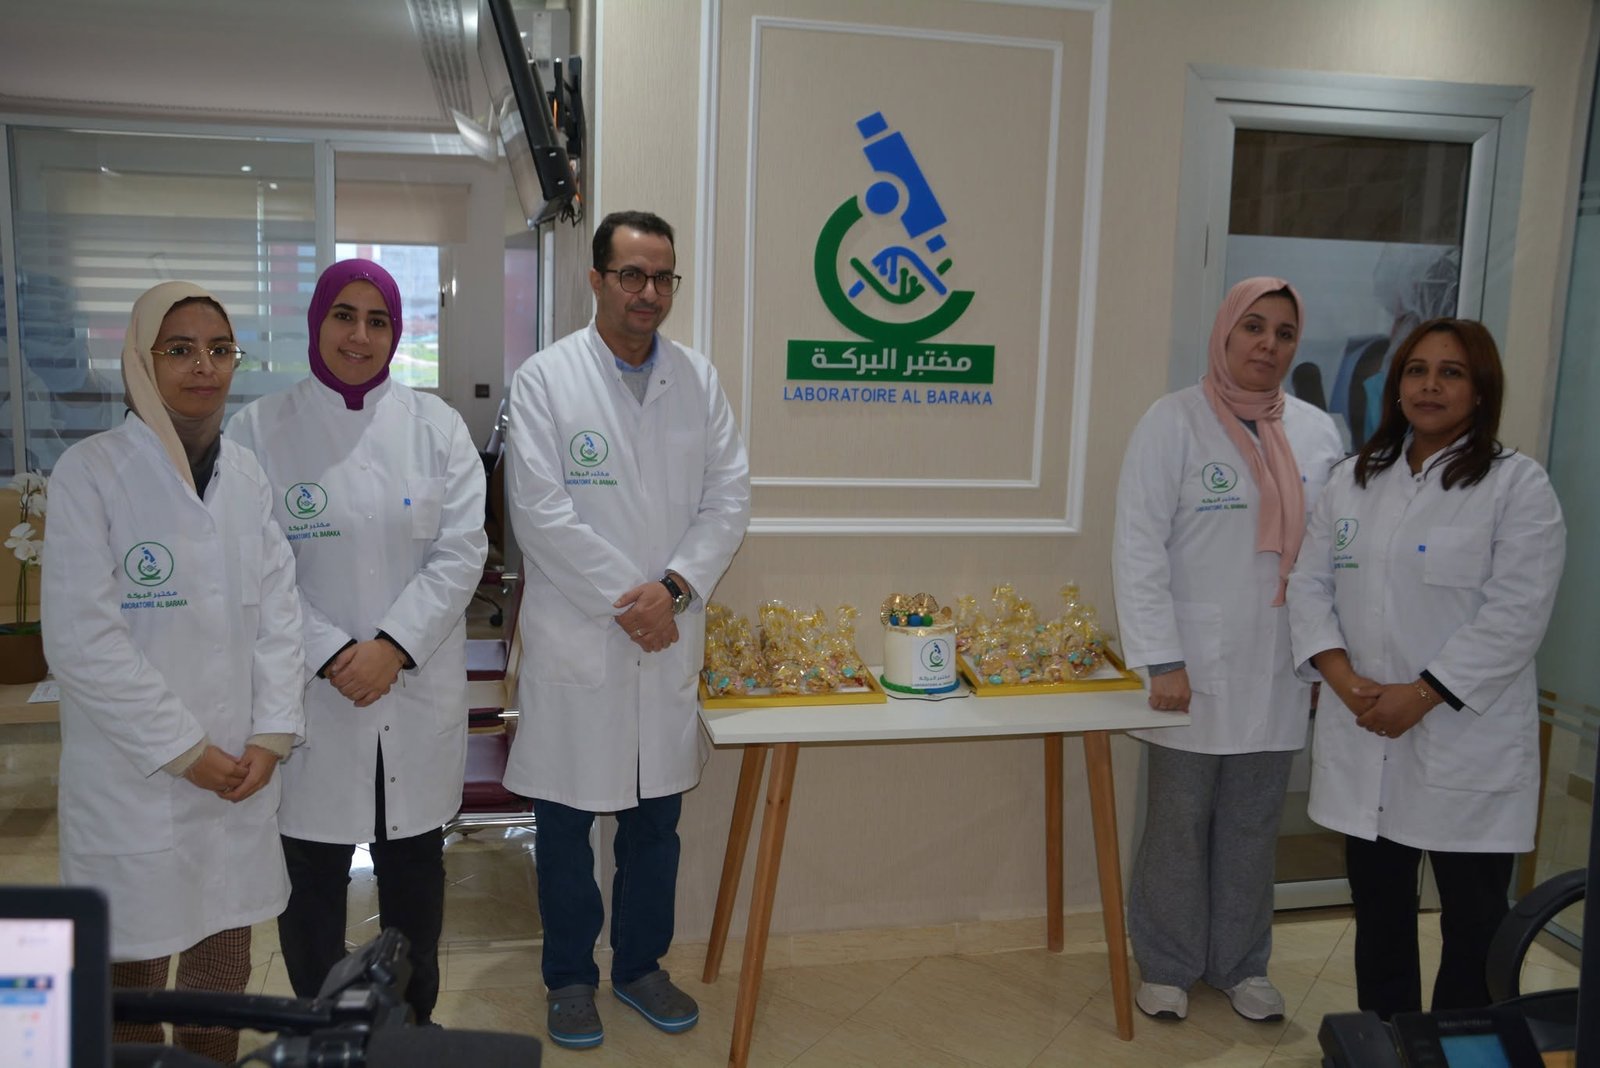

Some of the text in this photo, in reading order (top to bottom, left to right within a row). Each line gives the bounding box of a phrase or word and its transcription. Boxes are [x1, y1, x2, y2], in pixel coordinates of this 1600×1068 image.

[811, 347, 973, 376] مختبر البركة
[784, 386, 993, 405] LABORATOIRE AL BARAKA
[156, 600, 165, 608] AL
[165, 599, 188, 607] BARAKA
